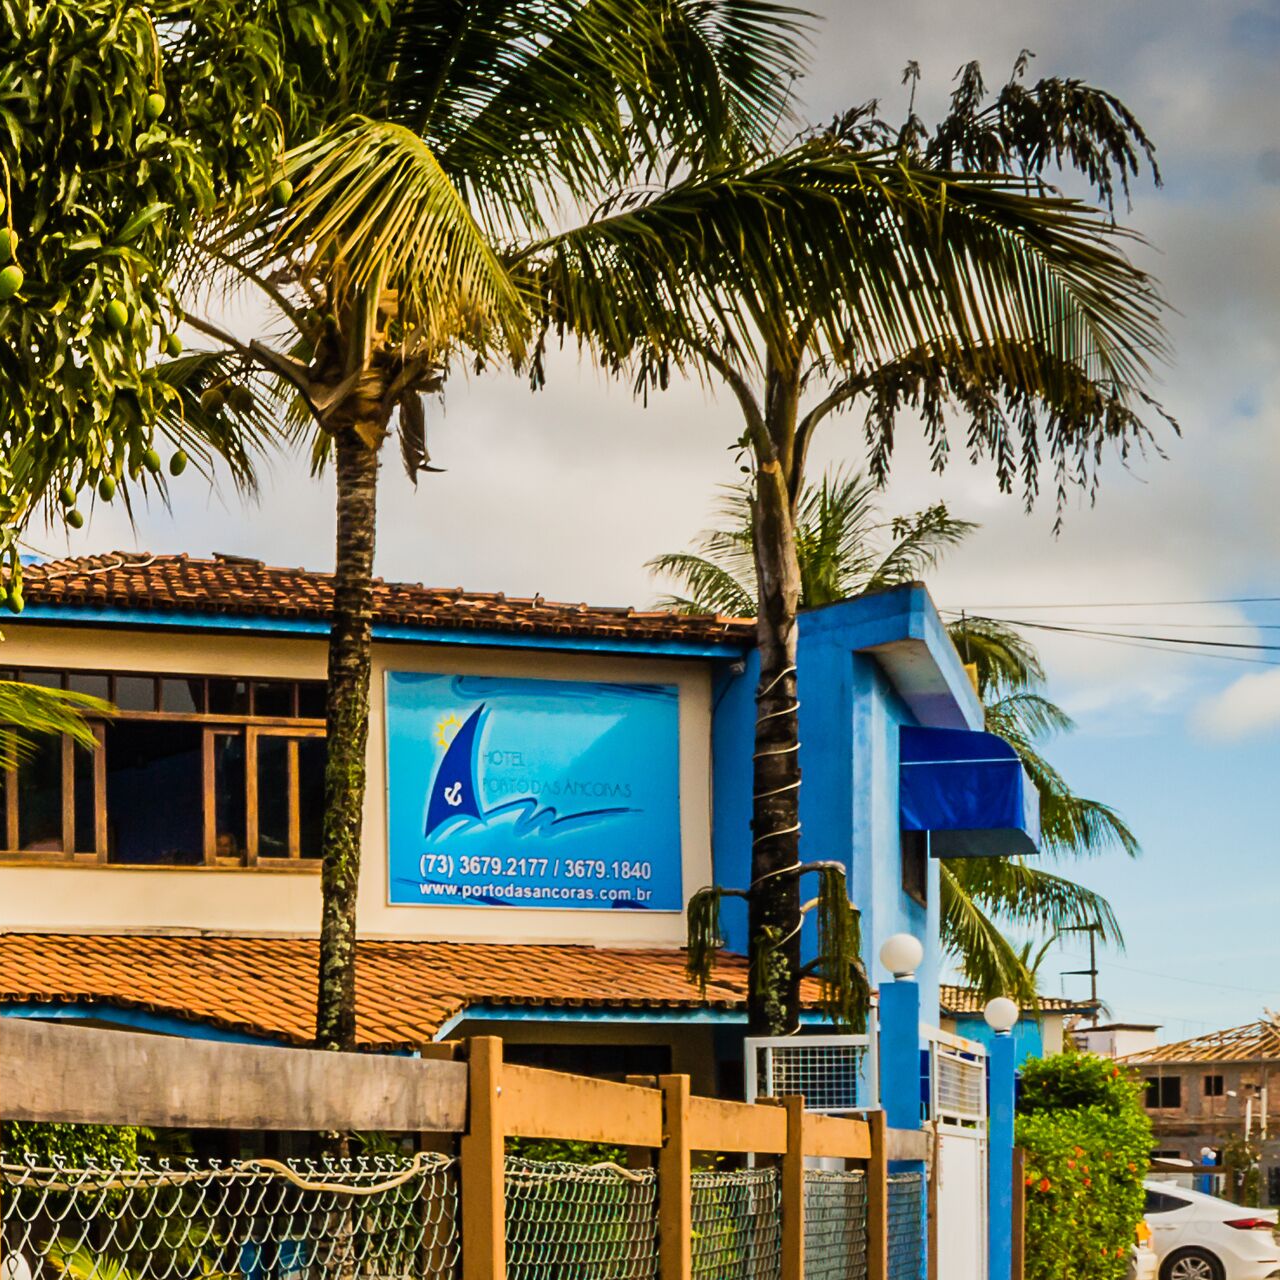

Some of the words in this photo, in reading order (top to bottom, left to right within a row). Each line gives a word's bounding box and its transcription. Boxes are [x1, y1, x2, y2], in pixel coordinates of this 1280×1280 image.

[482, 749, 526, 767] HOTEL
[530, 780, 561, 795] DAS
[419, 853, 455, 878] (73)
[458, 855, 549, 877] 3679.2177
[564, 859, 652, 880] 3679.1840
[419, 882, 653, 901] www.portodasancoras.com.br
